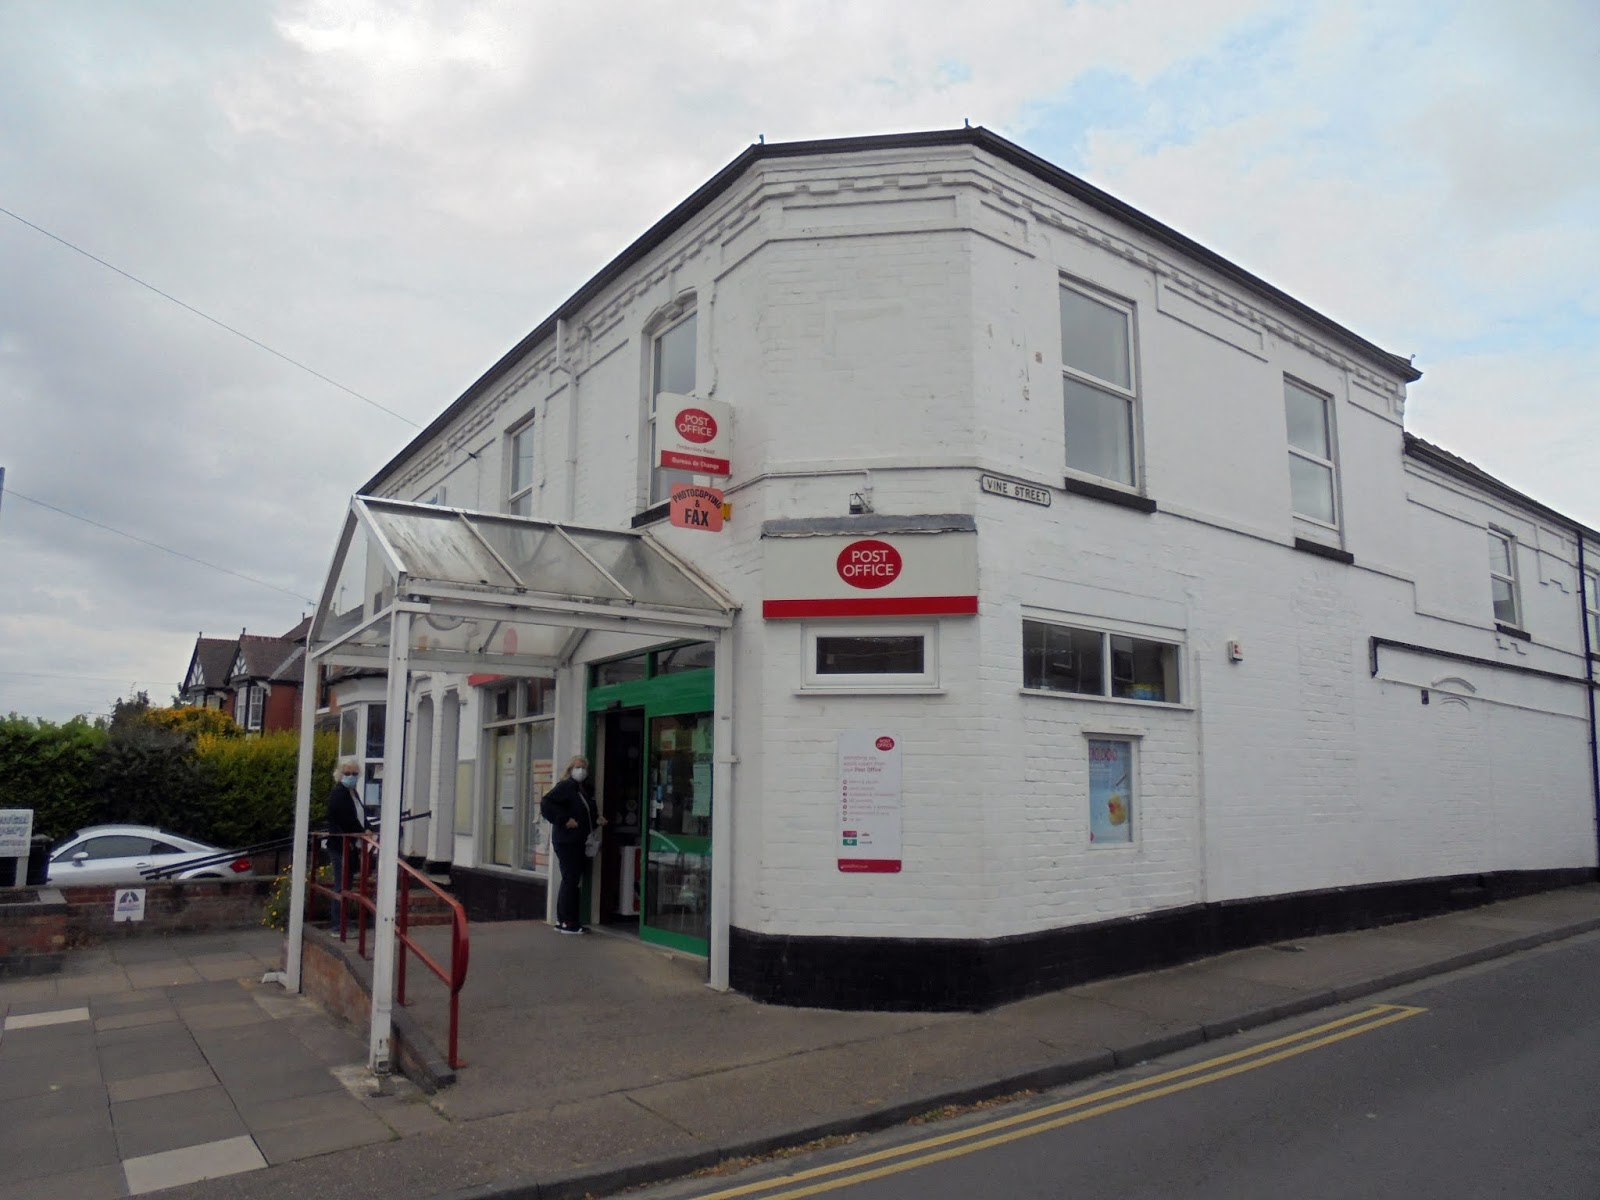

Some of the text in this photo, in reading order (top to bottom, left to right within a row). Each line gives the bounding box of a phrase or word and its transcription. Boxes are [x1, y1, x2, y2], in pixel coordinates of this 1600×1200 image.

[685, 414, 709, 427] POST
[679, 423, 712, 437] OFFICE
[672, 457, 692, 466] Bureau
[700, 462, 719, 470] Change
[987, 479, 1047, 502] VINE STREET
[672, 488, 722, 509] PHOTOCOPYING
[695, 499, 700, 507] &
[685, 508, 709, 527] FAX
[852, 550, 889, 563] POST
[843, 564, 894, 577] OFFICE
